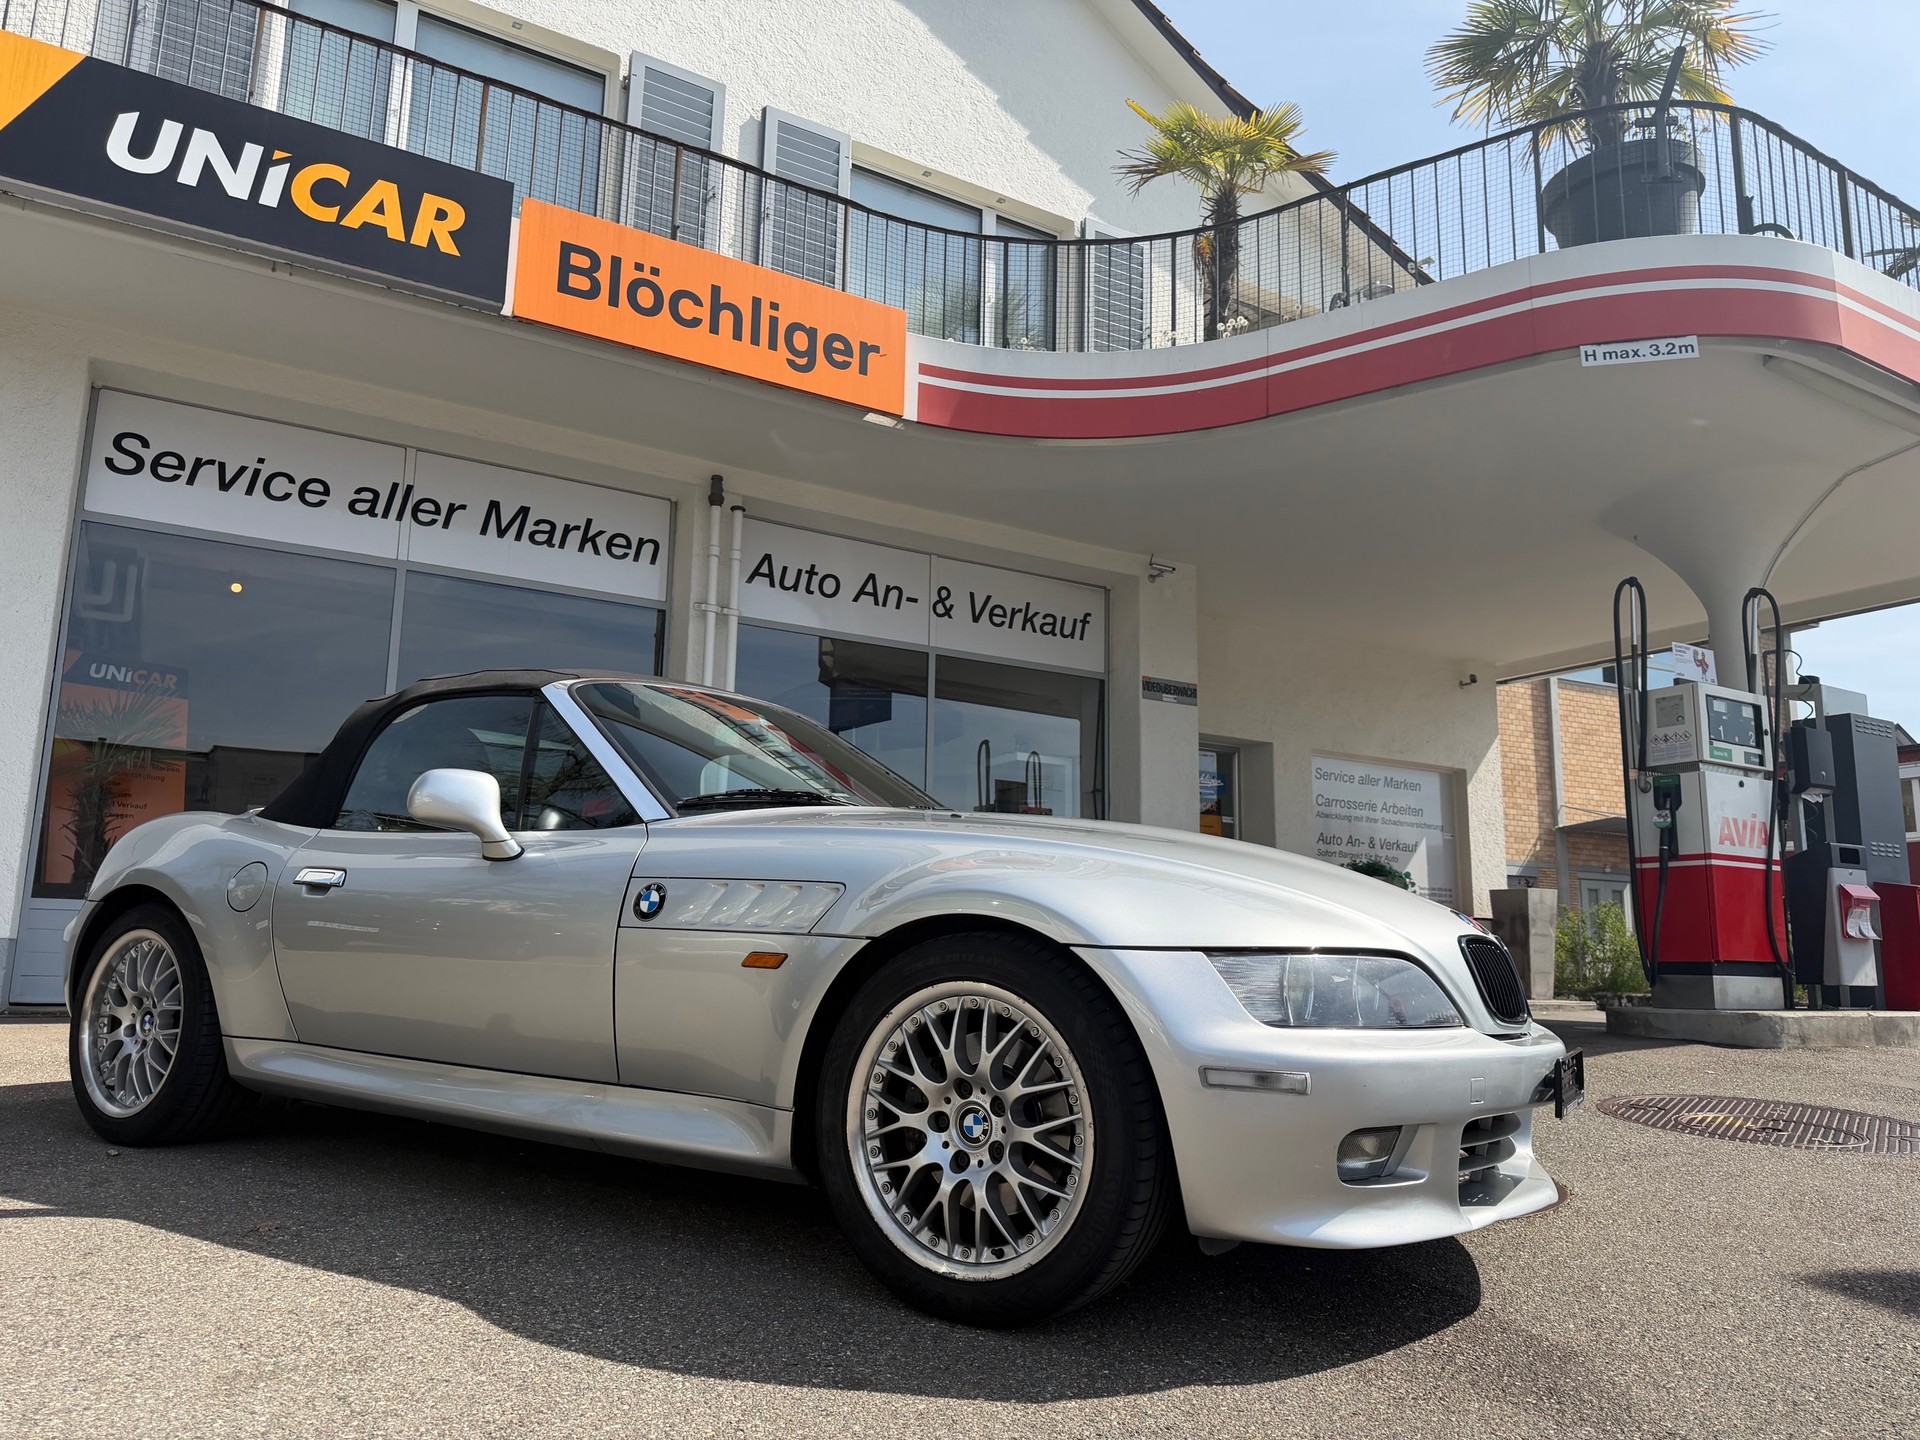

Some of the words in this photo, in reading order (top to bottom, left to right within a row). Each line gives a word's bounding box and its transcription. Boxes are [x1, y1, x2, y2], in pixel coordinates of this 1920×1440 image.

[556, 240, 881, 377] Blöchliger
[1584, 349, 1597, 361] H
[1602, 347, 1646, 360] max.
[1649, 342, 1695, 356] 3.2m
[104, 432, 331, 508] Service
[347, 482, 467, 530] aller
[479, 499, 660, 566] Marken
[745, 553, 841, 599] Auto
[852, 572, 919, 610] An-
[931, 585, 954, 620] &
[968, 591, 1092, 641] Verkauf
[1748, 731, 1757, 747] 2
[1314, 767, 1355, 785] Service
[1358, 774, 1381, 787] aller
[1383, 776, 1422, 792] Marken
[1315, 793, 1377, 812] Carrosserie
[1380, 801, 1424, 818] Arbeiten
[1316, 832, 1343, 847] Auto
[1345, 835, 1365, 848] An-
[1368, 837, 1376, 849] &
[1379, 837, 1418, 853] Verkauf
[1316, 849, 1337, 858] Sofort
[1384, 855, 1399, 863] Auto
[978, 1110, 989, 1142] BMW
